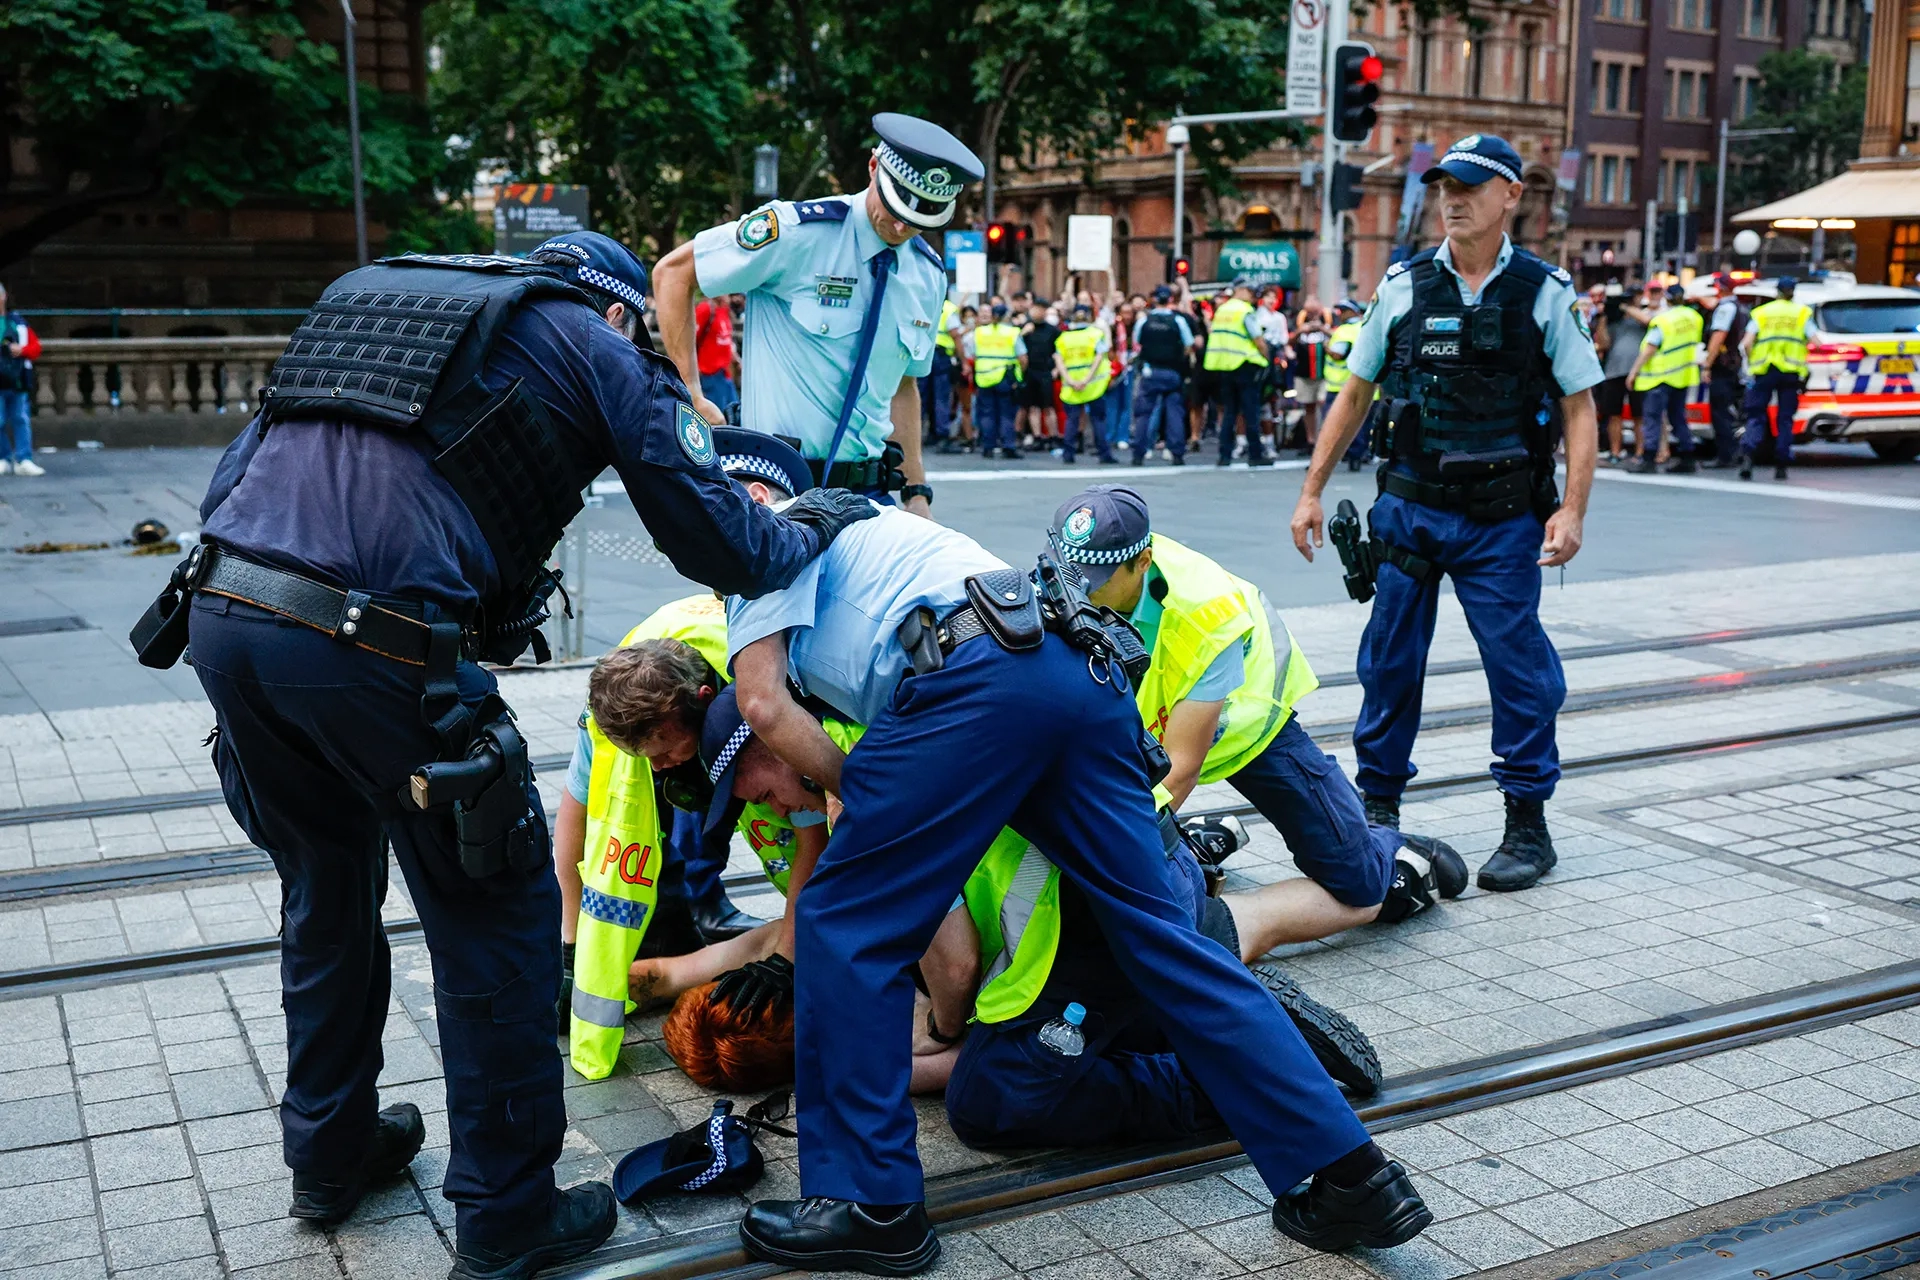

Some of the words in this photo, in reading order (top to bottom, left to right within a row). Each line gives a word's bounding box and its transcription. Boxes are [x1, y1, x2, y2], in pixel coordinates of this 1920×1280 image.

[569, 245, 591, 260] FORCE
[1229, 251, 1290, 270] OPALS
[1421, 345, 1460, 355] POLICE
